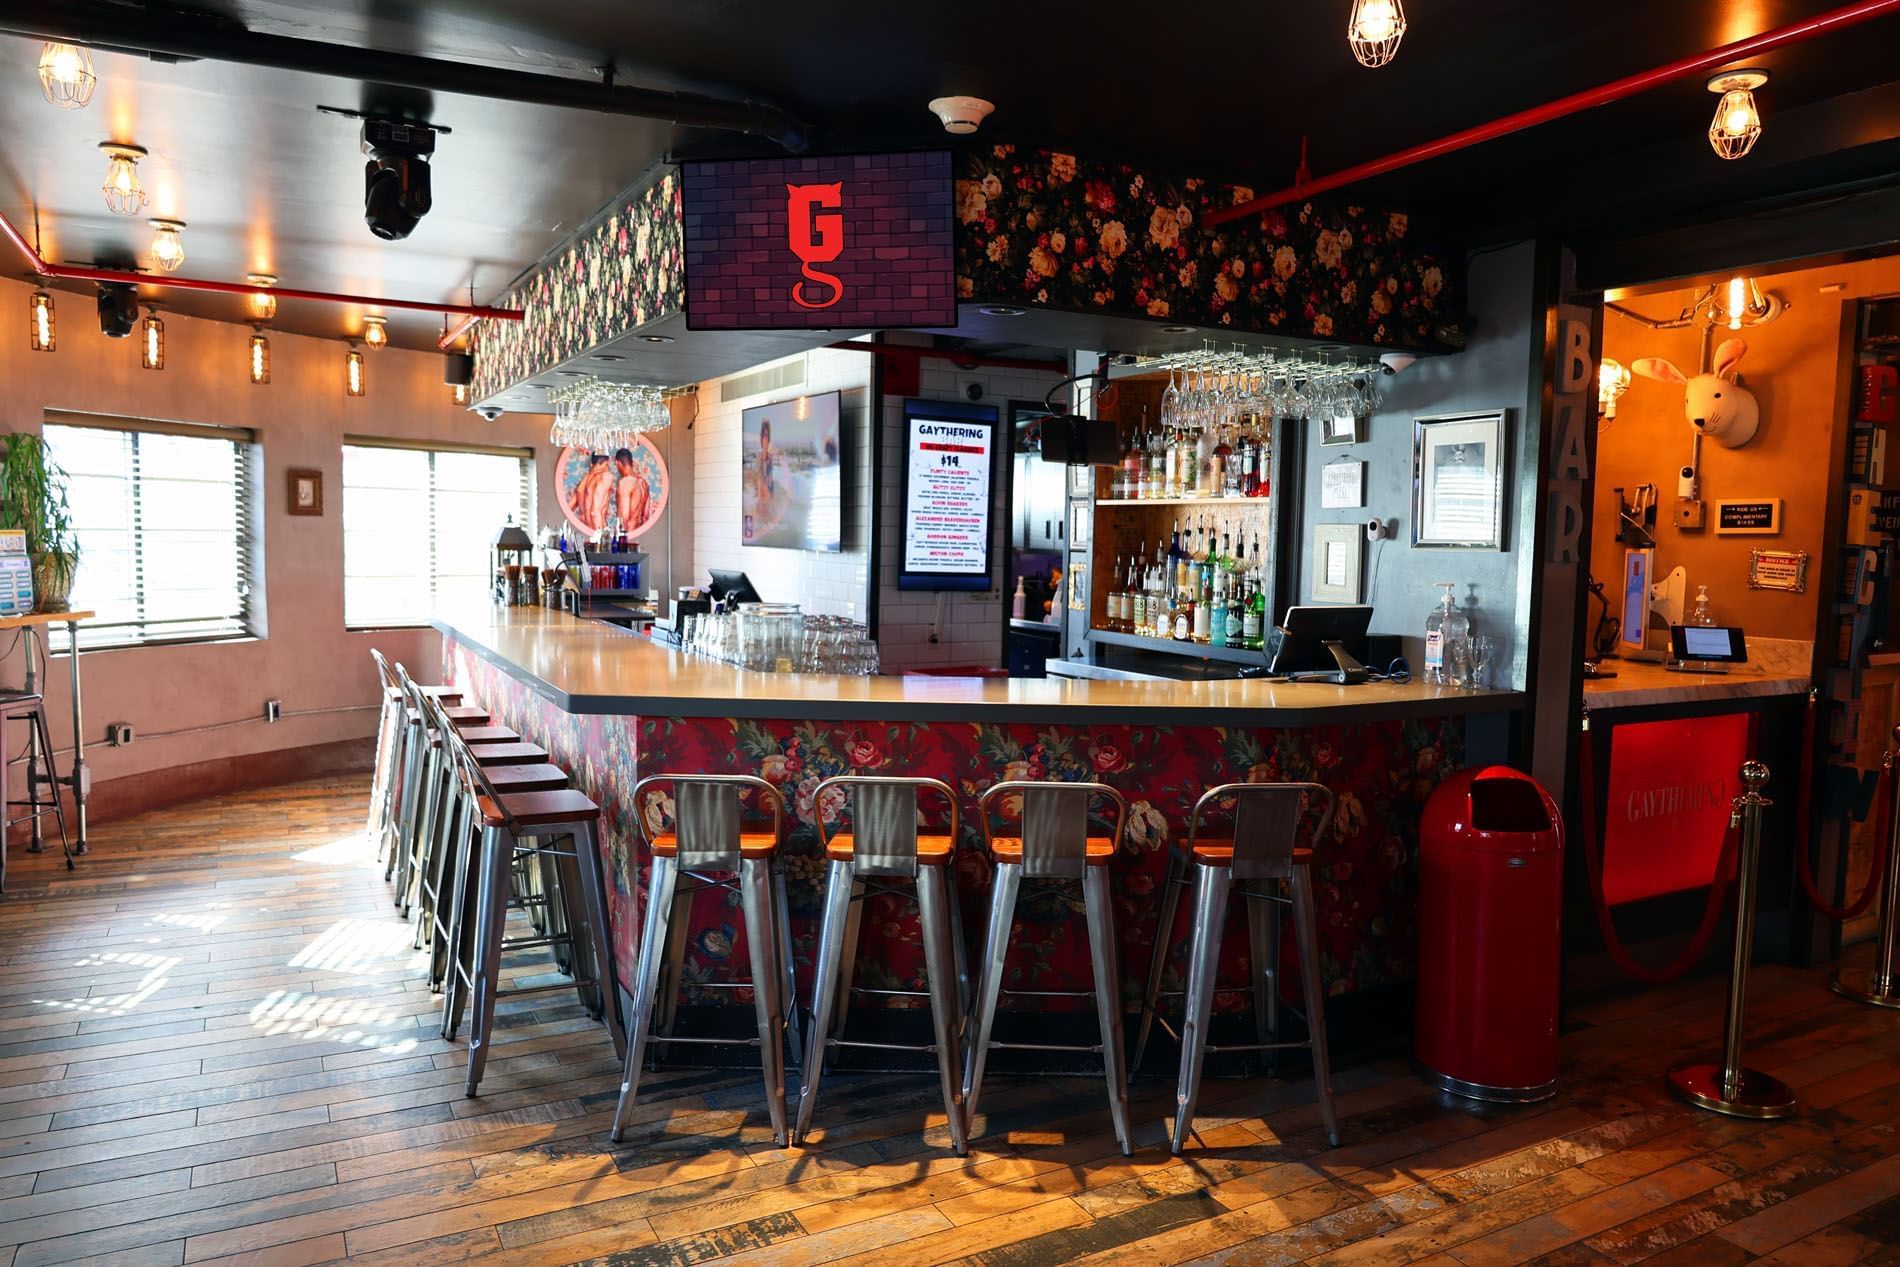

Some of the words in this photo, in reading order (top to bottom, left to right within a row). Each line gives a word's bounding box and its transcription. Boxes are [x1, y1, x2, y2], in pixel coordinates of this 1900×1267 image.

[919, 424, 984, 439] GAYTHERING
[1549, 318, 1593, 563] BAR
[941, 454, 959, 467] $14
